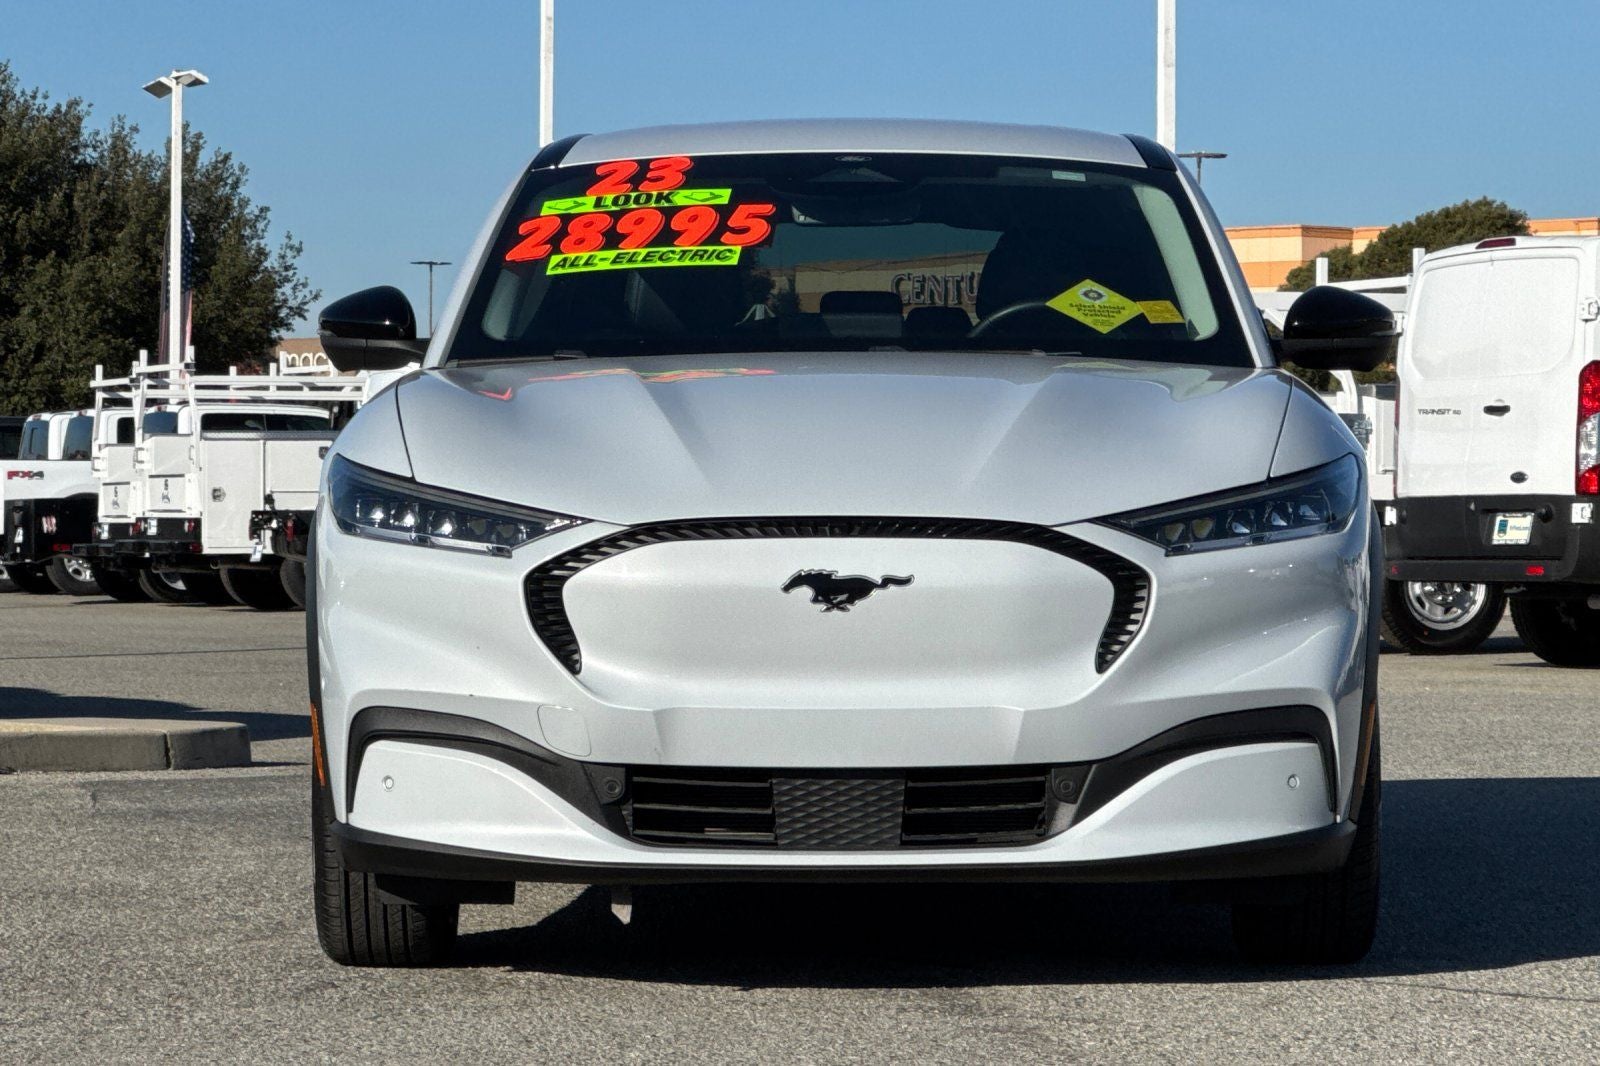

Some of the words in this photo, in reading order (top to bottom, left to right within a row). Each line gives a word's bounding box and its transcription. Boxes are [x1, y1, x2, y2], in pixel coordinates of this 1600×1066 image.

[586, 156, 694, 196] 23
[593, 191, 680, 209] LOOK
[505, 203, 777, 262] 28995
[550, 247, 737, 272] ALL-ELECTRIC
[7, 470, 45, 480] FX4
